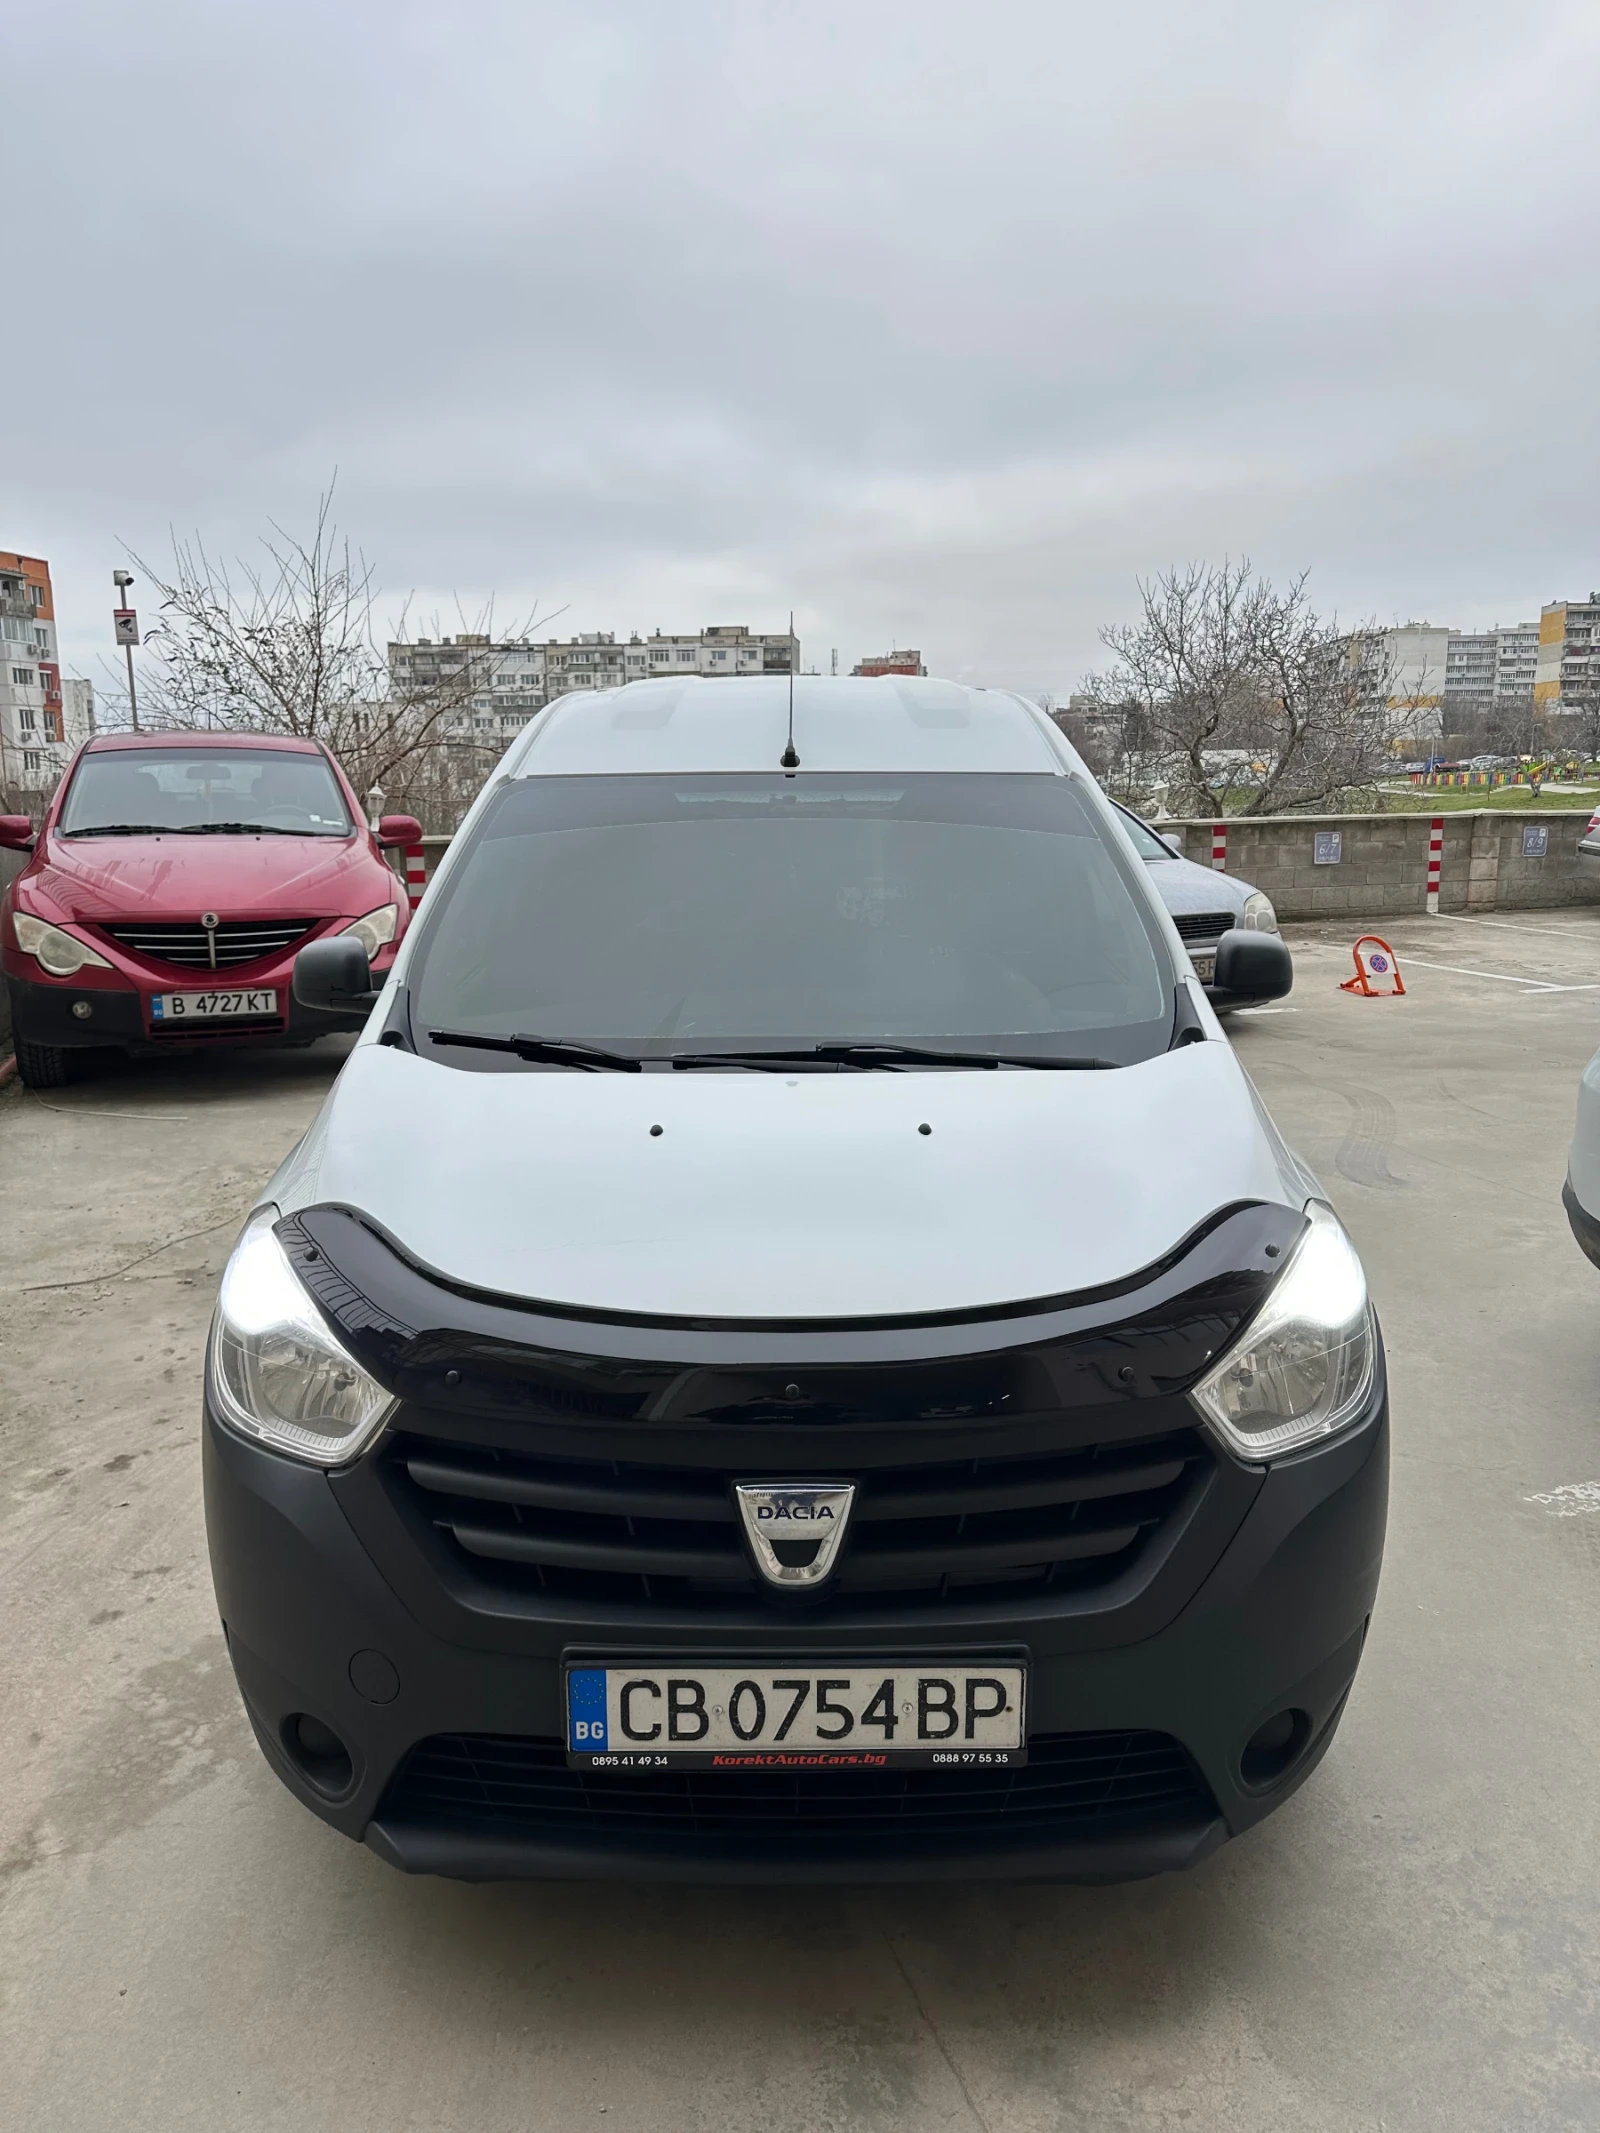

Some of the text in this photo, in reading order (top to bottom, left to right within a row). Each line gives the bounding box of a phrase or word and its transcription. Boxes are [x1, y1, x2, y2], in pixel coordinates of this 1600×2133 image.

[1319, 843, 1337, 854] 6/7
[1526, 837, 1544, 848] 8/9
[172, 993, 272, 1015] B 4727 KT
[757, 1506, 834, 1519] DACIA
[620, 1678, 1007, 1741] CB 0754 BP
[575, 1721, 604, 1740] BG
[592, 1756, 668, 1766] 0895 41 49 34
[712, 1753, 887, 1766] KorektAutoCars.bg
[932, 1753, 1009, 1763] 0888 97 55 35
